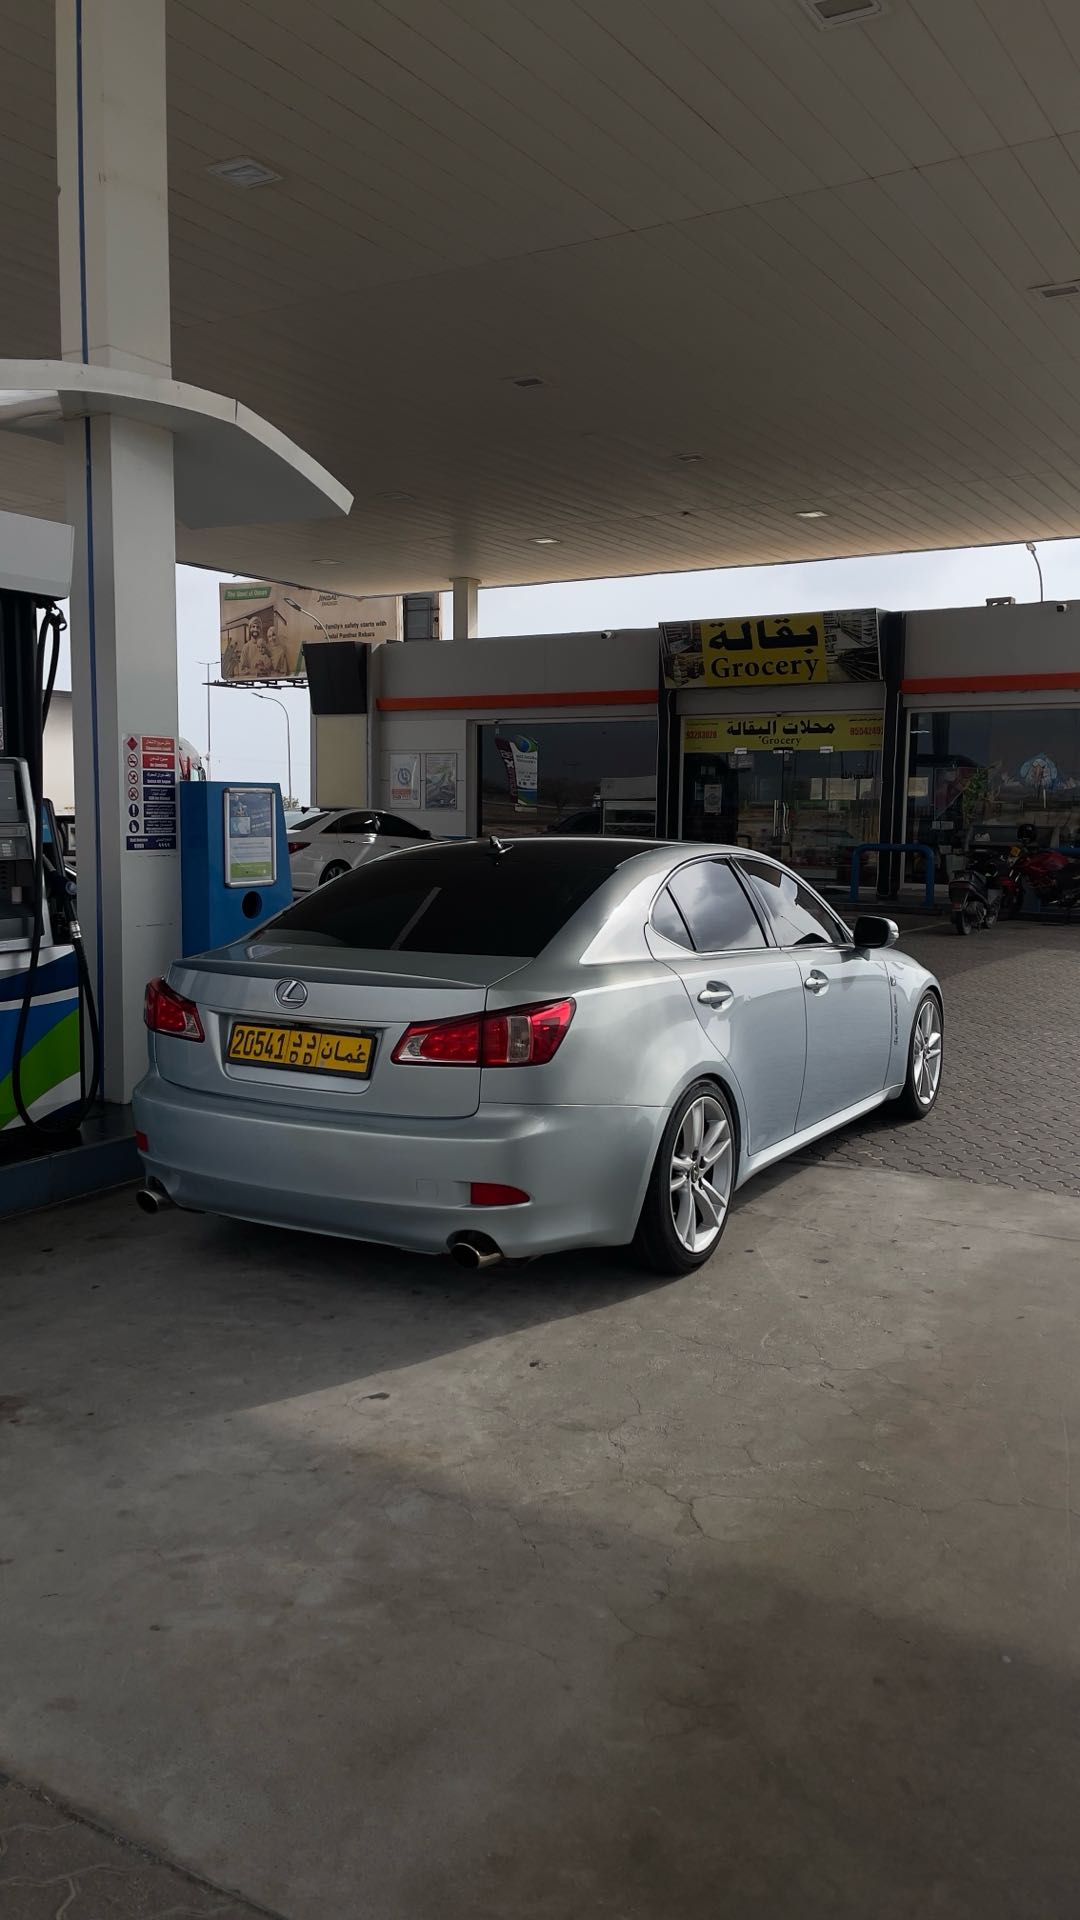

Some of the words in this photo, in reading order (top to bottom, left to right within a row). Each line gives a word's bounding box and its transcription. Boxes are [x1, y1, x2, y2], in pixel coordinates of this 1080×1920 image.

[709, 618, 818, 654] بقالة
[711, 657, 819, 681] Grocery
[727, 720, 777, 735] البقالة
[783, 720, 836, 734] محلات
[761, 735, 801, 746] Grocery
[232, 1029, 286, 1060] 20541
